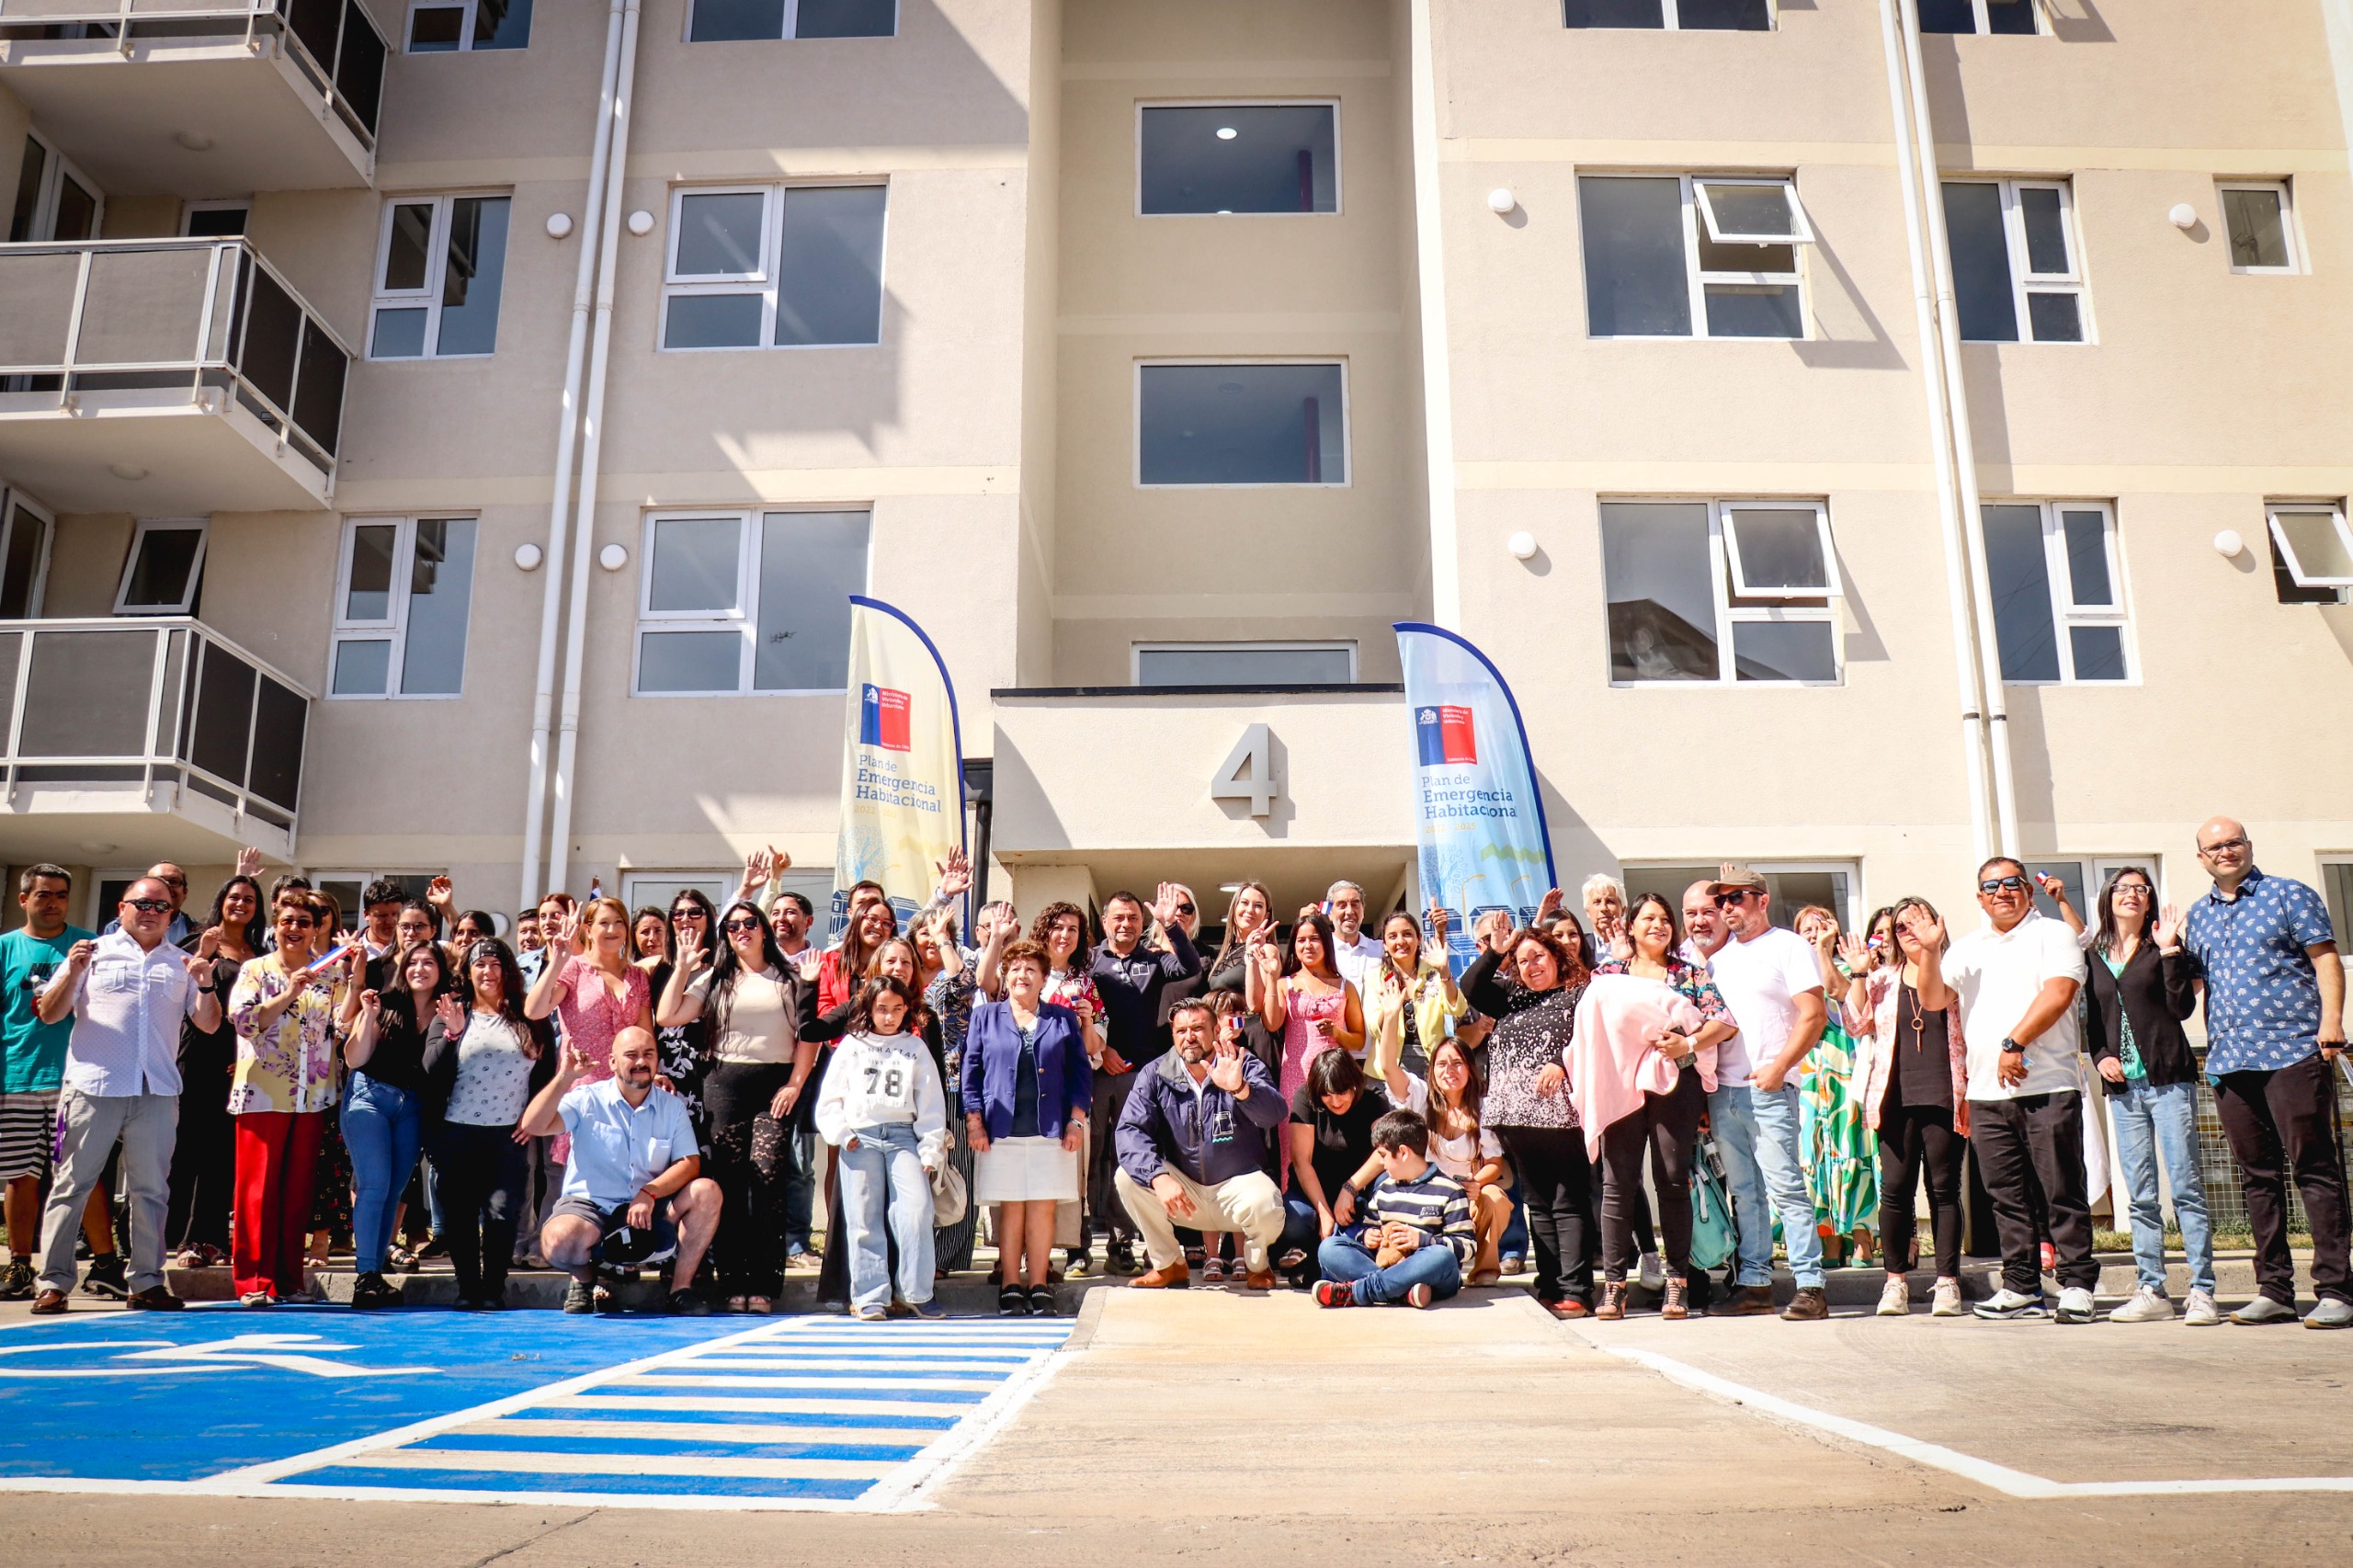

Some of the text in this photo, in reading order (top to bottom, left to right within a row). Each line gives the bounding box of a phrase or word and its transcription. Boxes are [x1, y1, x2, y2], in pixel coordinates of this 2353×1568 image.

[859, 755, 897, 772] Plan de
[1211, 723, 1278, 817] 4
[858, 768, 936, 795] Emergencia
[1422, 774, 1471, 788] Plan de
[856, 785, 941, 812] Habitacional
[1423, 789, 1513, 803] Emergencia
[28, 962, 62, 977] NIK
[864, 1068, 904, 1097] 78
